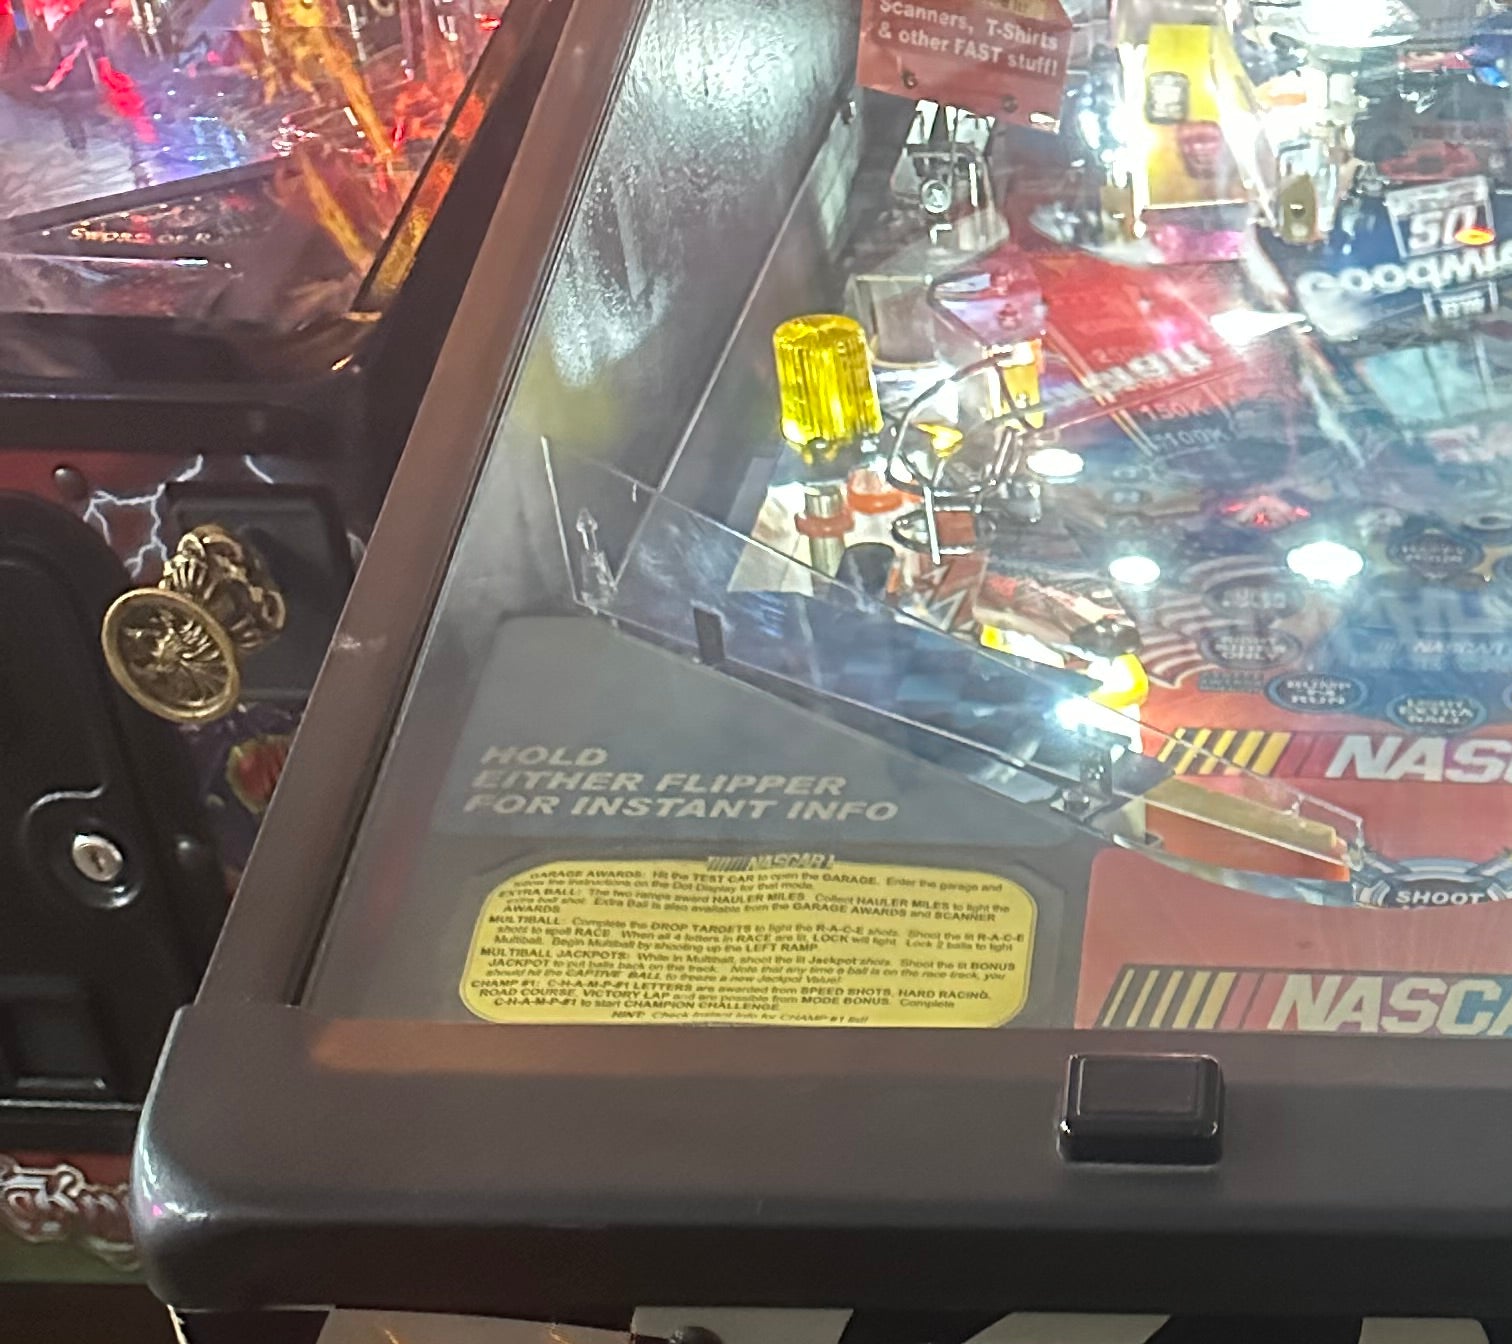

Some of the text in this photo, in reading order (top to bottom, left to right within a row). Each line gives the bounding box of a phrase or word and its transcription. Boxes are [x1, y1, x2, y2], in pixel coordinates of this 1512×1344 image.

[880, 0, 974, 34] Scanners,
[987, 18, 1058, 50] T-Shirts
[878, 21, 1058, 77] & other FAST stuff!
[480, 746, 608, 767] HOLD
[472, 769, 847, 797] EITHER FLIPPER
[463, 795, 899, 822] FOR INSTANT INFO
[747, 853, 829, 871] NASCAR
[531, 871, 582, 879] GARAGE
[694, 873, 724, 882] TEST
[498, 888, 541, 897] EXTRA
[712, 894, 764, 903] HAULER
[857, 896, 908, 907] HAULER
[912, 900, 949, 909] MILES
[1396, 890, 1485, 905] SHOOT
[793, 902, 847, 913] GARAGE
[851, 906, 906, 917] AWARDS
[934, 911, 996, 921] SCANNER
[651, 922, 688, 931] DROP
[692, 924, 751, 933] TARGETS
[816, 924, 864, 935] R-A-C-E
[977, 932, 1024, 942] R-A-C-E
[736, 933, 771, 942] RACE
[813, 933, 848, 943] LOCK
[745, 944, 776, 952] LEFT
[480, 948, 552, 958] MULTIBALL
[557, 949, 630, 960] JACKPOTS:
[970, 962, 1015, 971] BONUS
[488, 958, 549, 967] JACKPOT
[565, 969, 621, 978] CAPTIVE
[628, 970, 662, 980] BALL
[471, 979, 518, 988] CHAMP
[633, 982, 692, 992] LETTERS
[800, 986, 844, 995] SPEED
[899, 989, 935, 999] HARD
[479, 988, 517, 997] ROAD
[582, 990, 639, 999] VICTORY
[643, 991, 670, 1000] LAP
[801, 996, 840, 1004] MODE
[623, 1000, 696, 1009] CHAMPION
